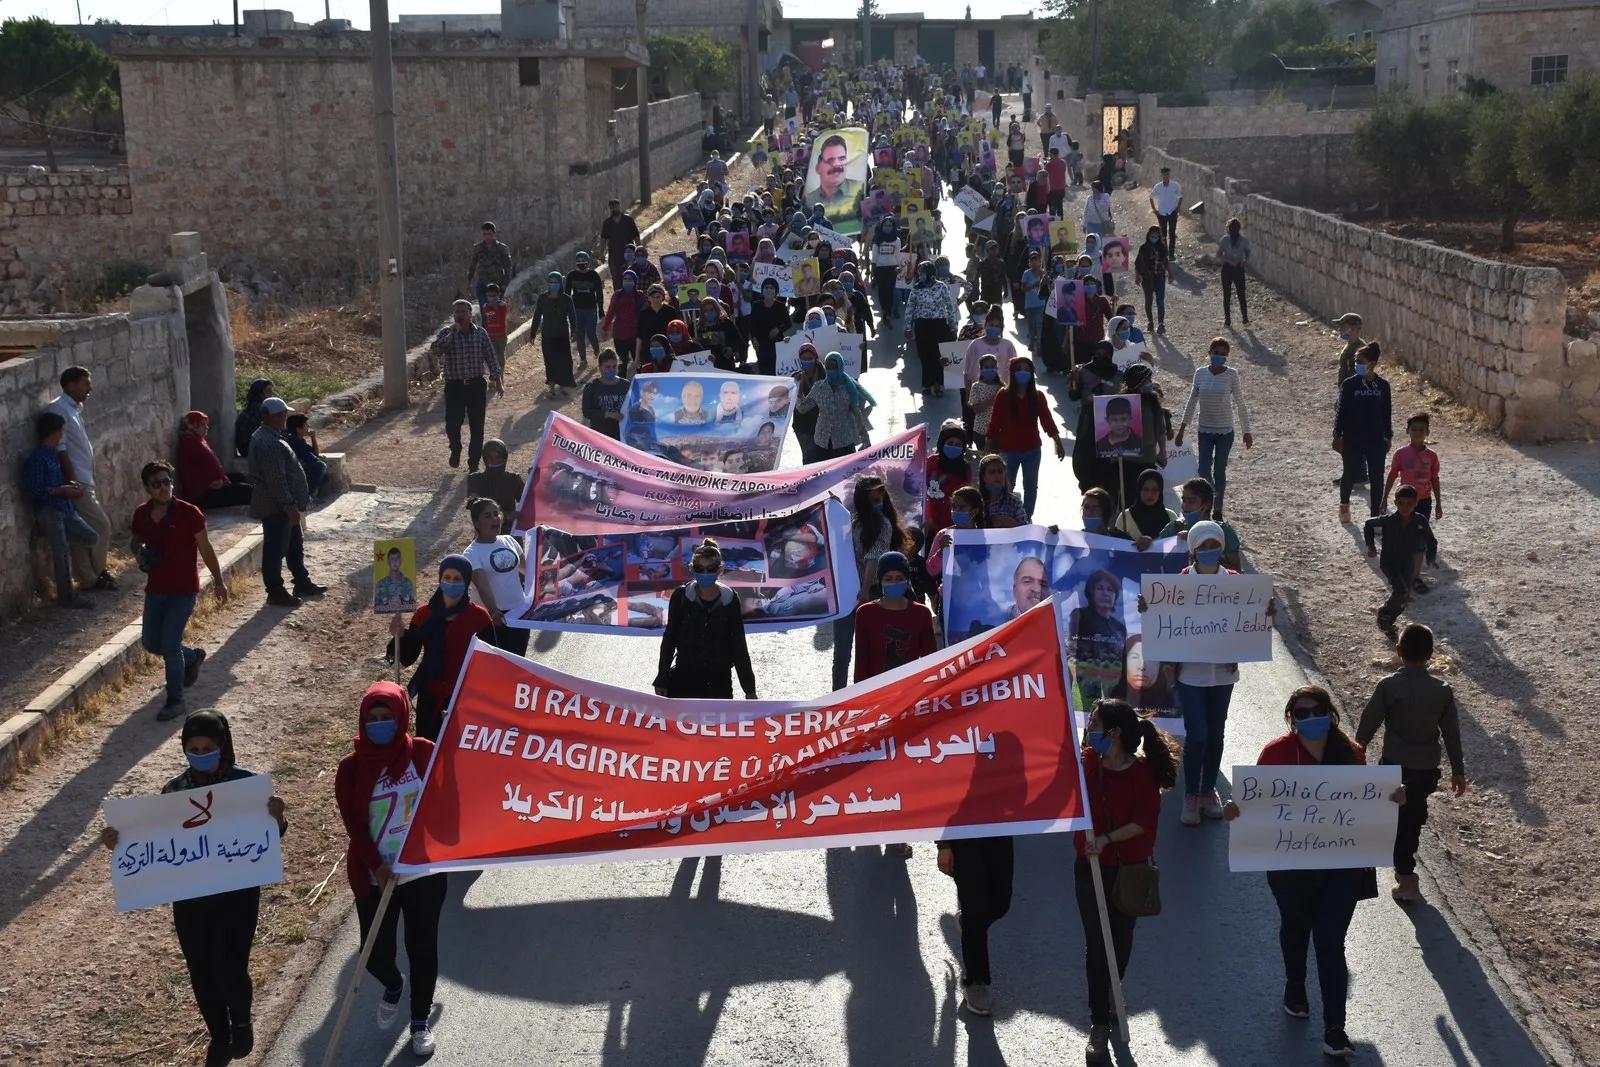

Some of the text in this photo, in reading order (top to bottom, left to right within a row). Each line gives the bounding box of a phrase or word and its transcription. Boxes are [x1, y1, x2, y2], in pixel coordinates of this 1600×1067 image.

[458, 724, 520, 757] EMÊ
[521, 733, 732, 783] DAGIRKERIYÊ
[959, 673, 1047, 708] BIBIN
[543, 689, 668, 732] RASTIYA
[904, 724, 996, 765] بالحرب
[801, 786, 902, 825] سندحر
[1241, 776, 1262, 801] Bi
[1270, 778, 1297, 799] Dil
[1362, 782, 1383, 801] Bi
[182, 790, 214, 829] لا
[117, 840, 154, 877] التركية
[156, 834, 210, 866] الدولة
